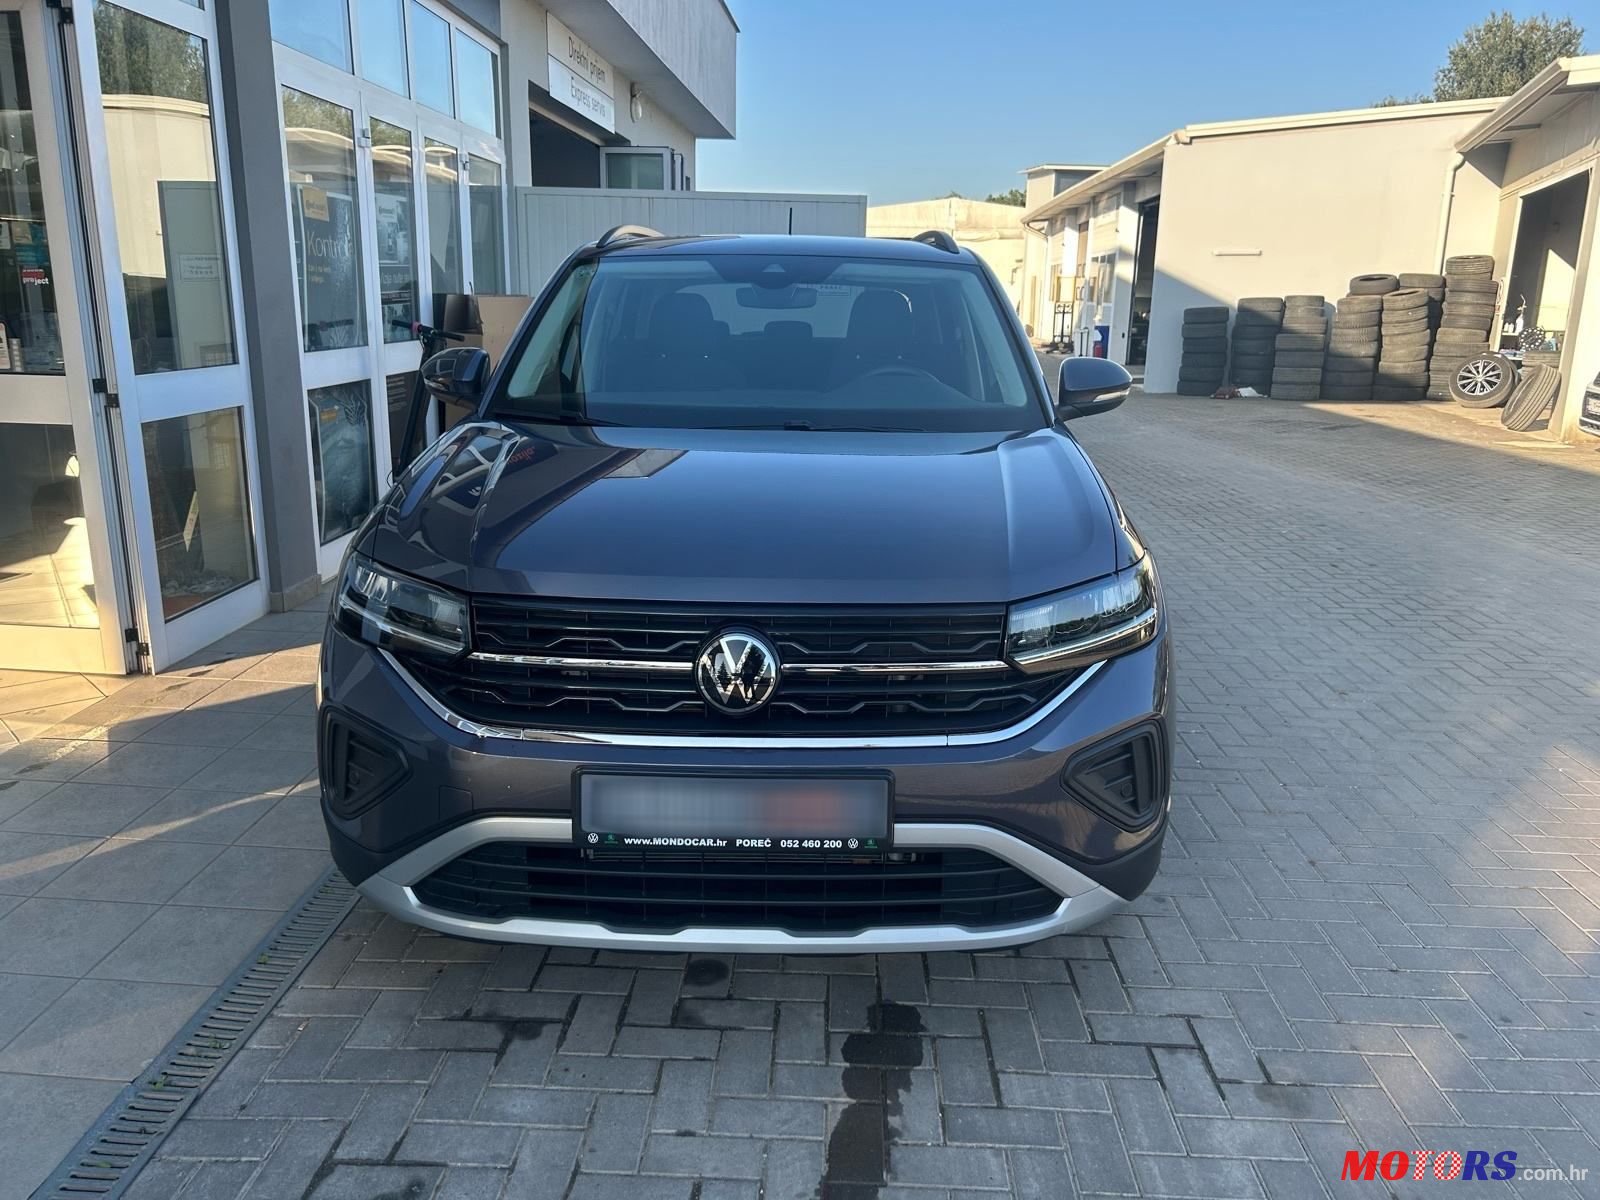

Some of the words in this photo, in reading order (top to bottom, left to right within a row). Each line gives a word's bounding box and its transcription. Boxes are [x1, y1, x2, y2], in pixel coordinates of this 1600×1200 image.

[571, 76, 591, 109] Express
[699, 634, 775, 711] VW
[624, 837, 728, 848] www.MONDOCAR.hr
[736, 838, 772, 848] POREČ
[780, 839, 800, 849] 052
[802, 839, 821, 849] 460
[823, 839, 843, 849] 200
